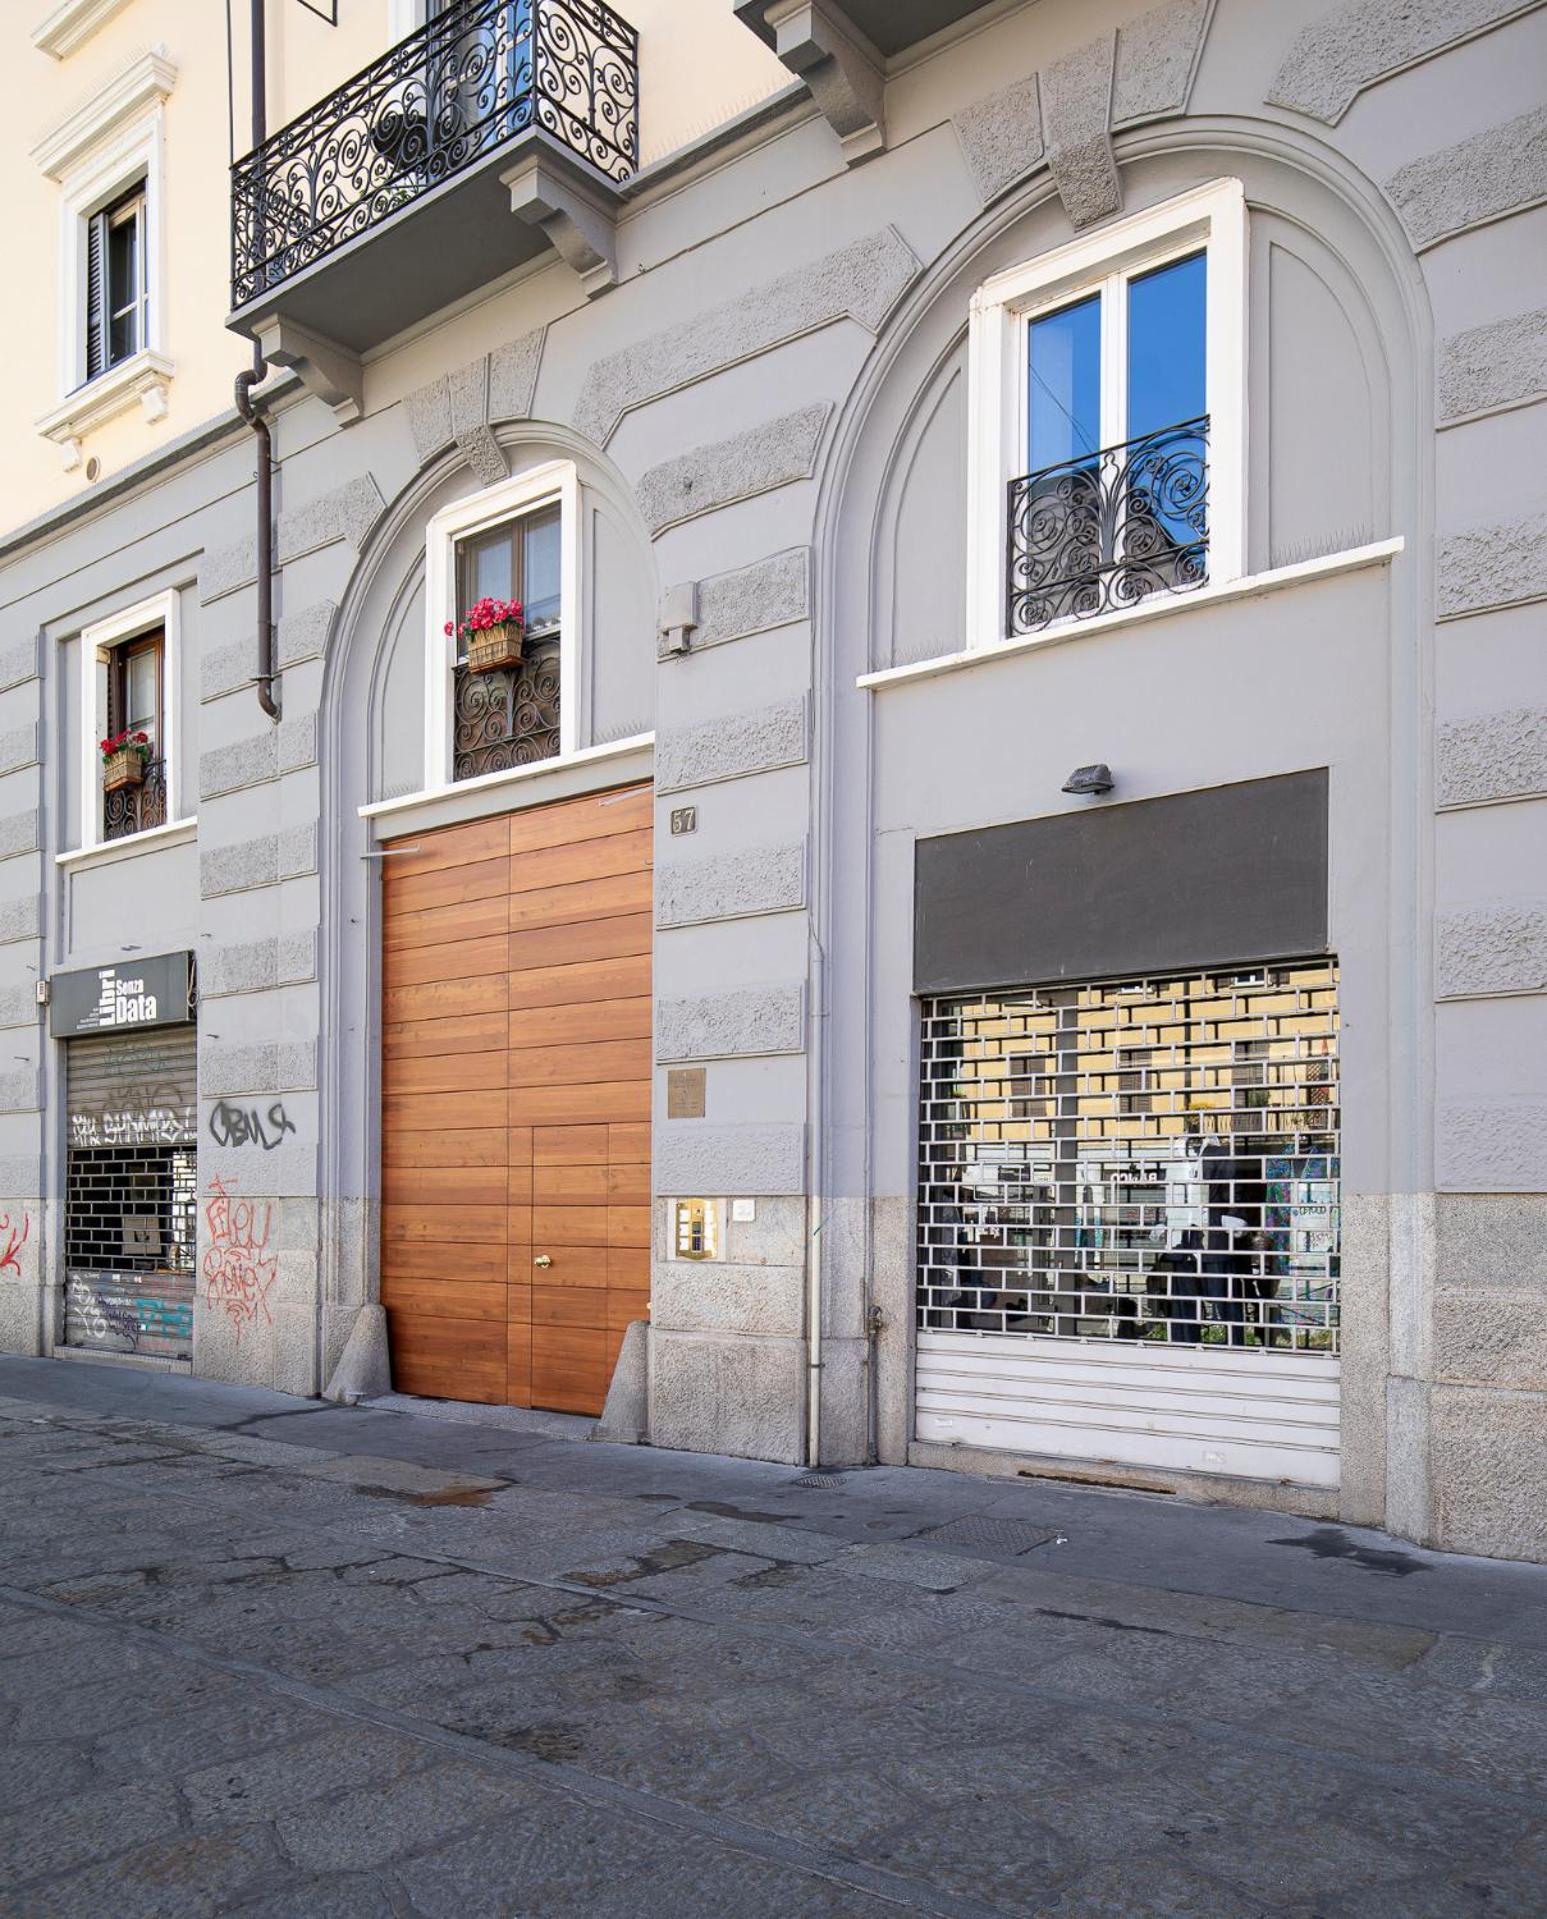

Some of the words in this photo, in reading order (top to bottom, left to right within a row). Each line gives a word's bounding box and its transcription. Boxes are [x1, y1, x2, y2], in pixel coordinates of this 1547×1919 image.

[674, 809, 694, 832] 57
[99, 969, 115, 1026] Libri
[116, 979, 144, 995] Senza
[116, 994, 157, 1024] Data
